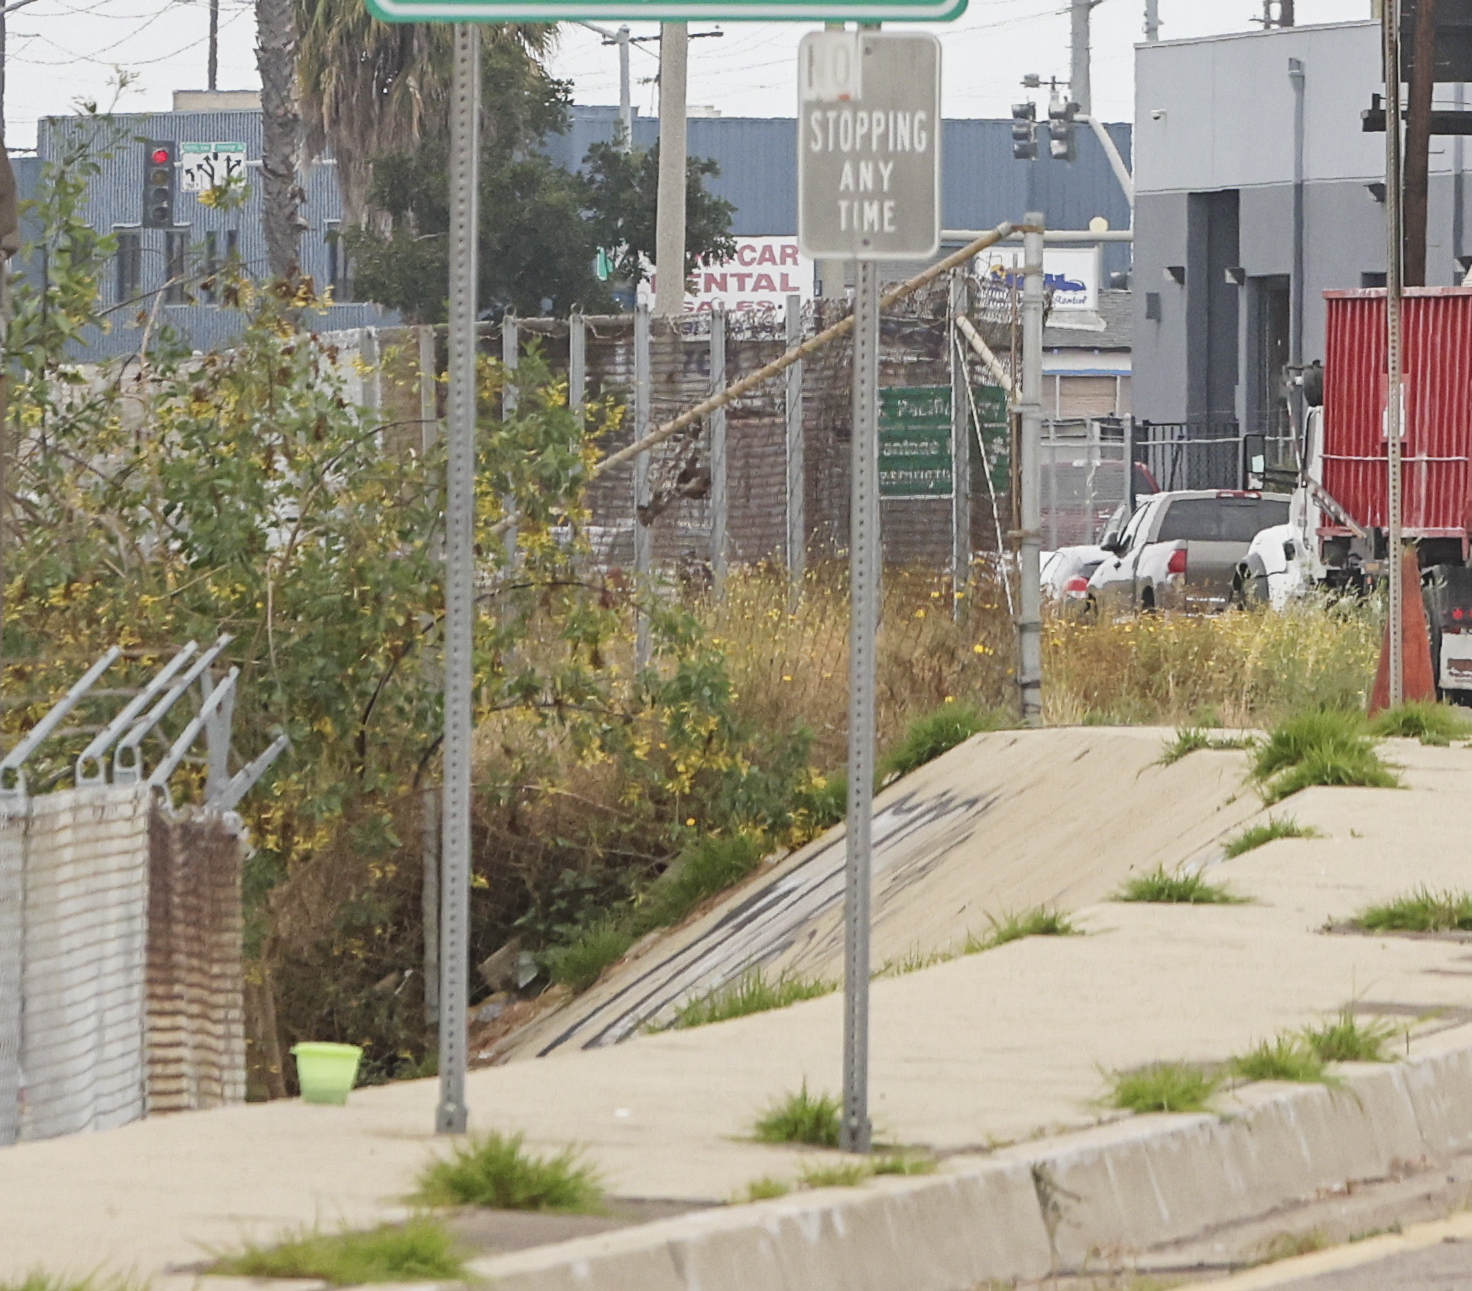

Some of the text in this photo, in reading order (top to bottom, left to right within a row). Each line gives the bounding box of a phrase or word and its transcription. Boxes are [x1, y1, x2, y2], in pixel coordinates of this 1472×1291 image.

[811, 109, 926, 152] STOPPING
[840, 160, 893, 191] ANY
[839, 200, 895, 232] TIME
[738, 244, 799, 266] CAR
